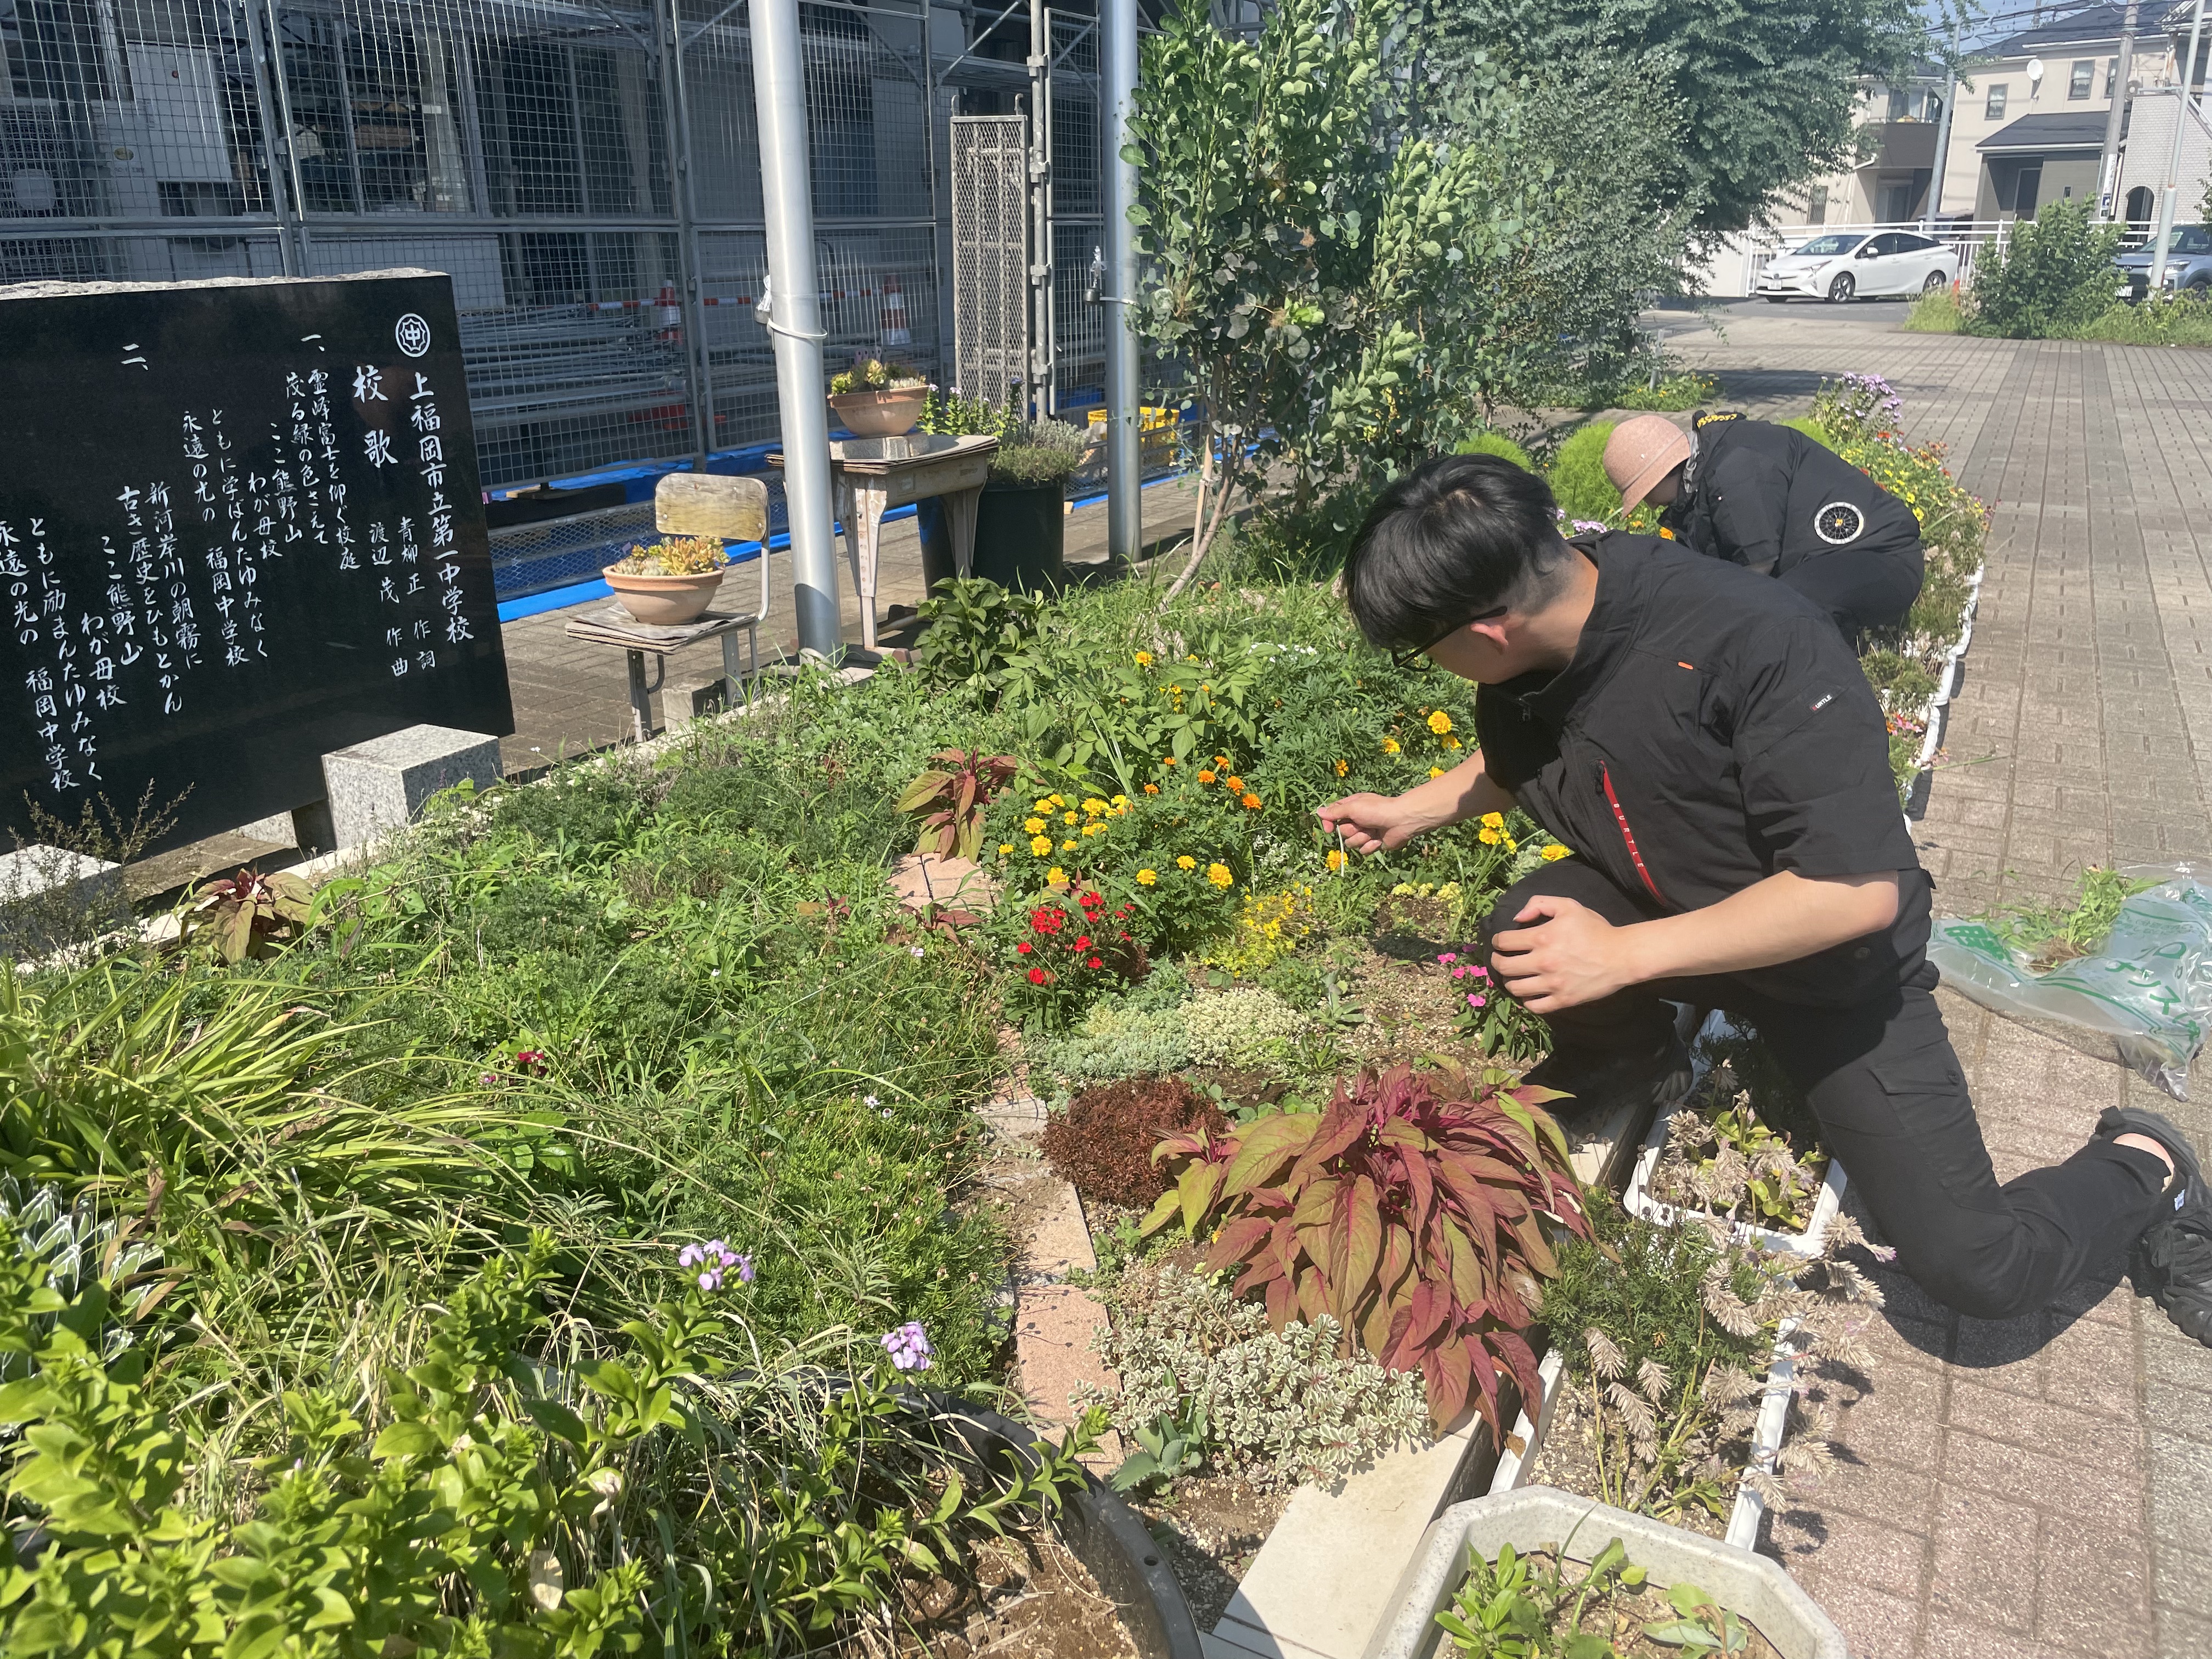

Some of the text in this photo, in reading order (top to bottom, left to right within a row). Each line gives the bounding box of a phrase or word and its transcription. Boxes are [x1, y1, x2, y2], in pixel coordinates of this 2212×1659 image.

[285, 372, 329, 544] 茂る緑の色さえて
[308, 368, 362, 571] 霊峰富士を仰ぐ校庭
[353, 365, 399, 468] 校歌
[183, 410, 250, 667] 永遠の光の 福岡中学校
[248, 472, 283, 560] わが母校
[270, 422, 302, 543] ここ熊野山
[409, 371, 475, 644] 上福岡市立第一中学校
[101, 535, 143, 665] ここ熊野山
[116, 486, 182, 714] 古き歴史をひもとかん
[145, 481, 202, 670] 新河岸川の朝霧に
[81, 612, 128, 710] わが母校
[386, 628, 408, 677] 作曲
[414, 619, 436, 670] 作詞
[26, 667, 81, 792] 福岡中学校
